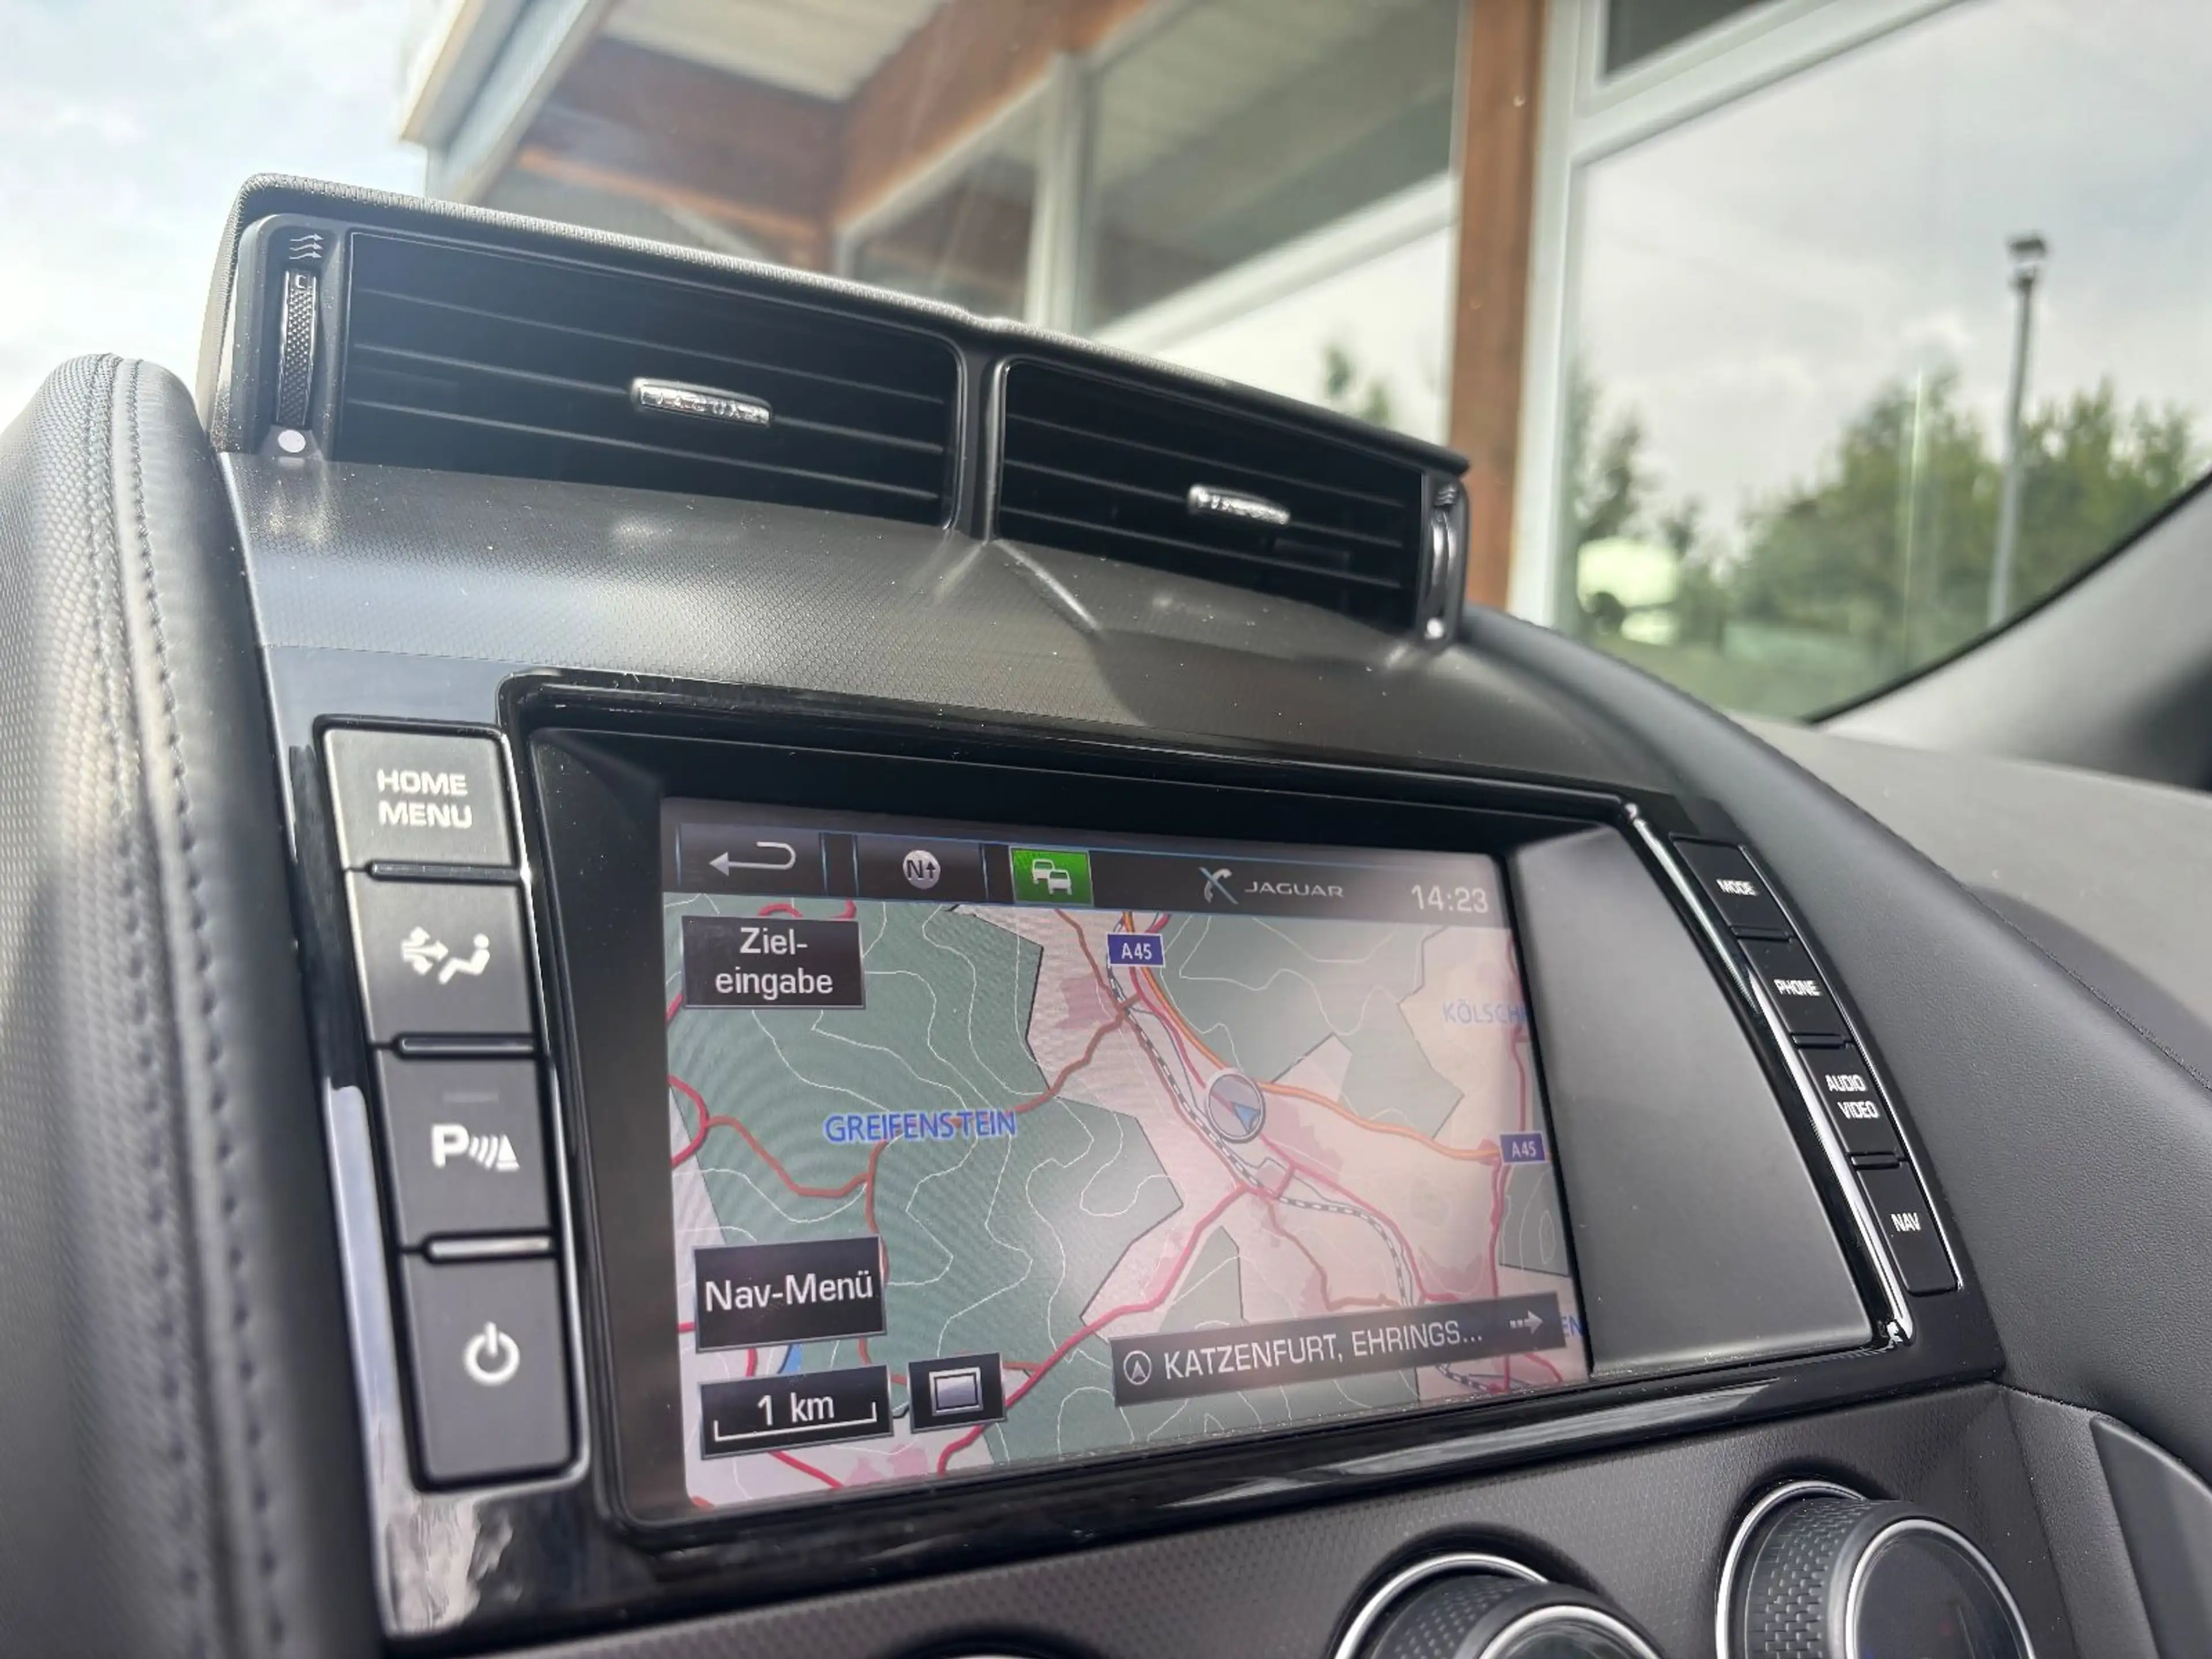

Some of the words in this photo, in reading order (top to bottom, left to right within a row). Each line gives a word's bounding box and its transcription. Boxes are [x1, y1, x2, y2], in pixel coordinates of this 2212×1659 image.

[377, 768, 468, 796] HOME
[378, 800, 472, 828] MENU
[907, 859, 924, 878] N
[1244, 881, 1344, 897] JAGUAR
[1411, 885, 1488, 913] 14:23
[1716, 878, 1759, 896] MODE
[740, 927, 808, 956] Ziel-
[715, 968, 834, 1001] eingabe
[1774, 979, 1821, 997] PHONE
[1825, 1074, 1868, 1092] AUDIO
[1837, 1100, 1880, 1119] VIDEO
[823, 1109, 1017, 1143] GREIFENSTEIN
[1891, 1212, 1922, 1232] NAV
[705, 1271, 873, 1312] Nav-Menü
[1163, 1334, 1343, 1380] KATZENFURT,
[757, 1395, 772, 1426] 1
[790, 1392, 835, 1423] km
